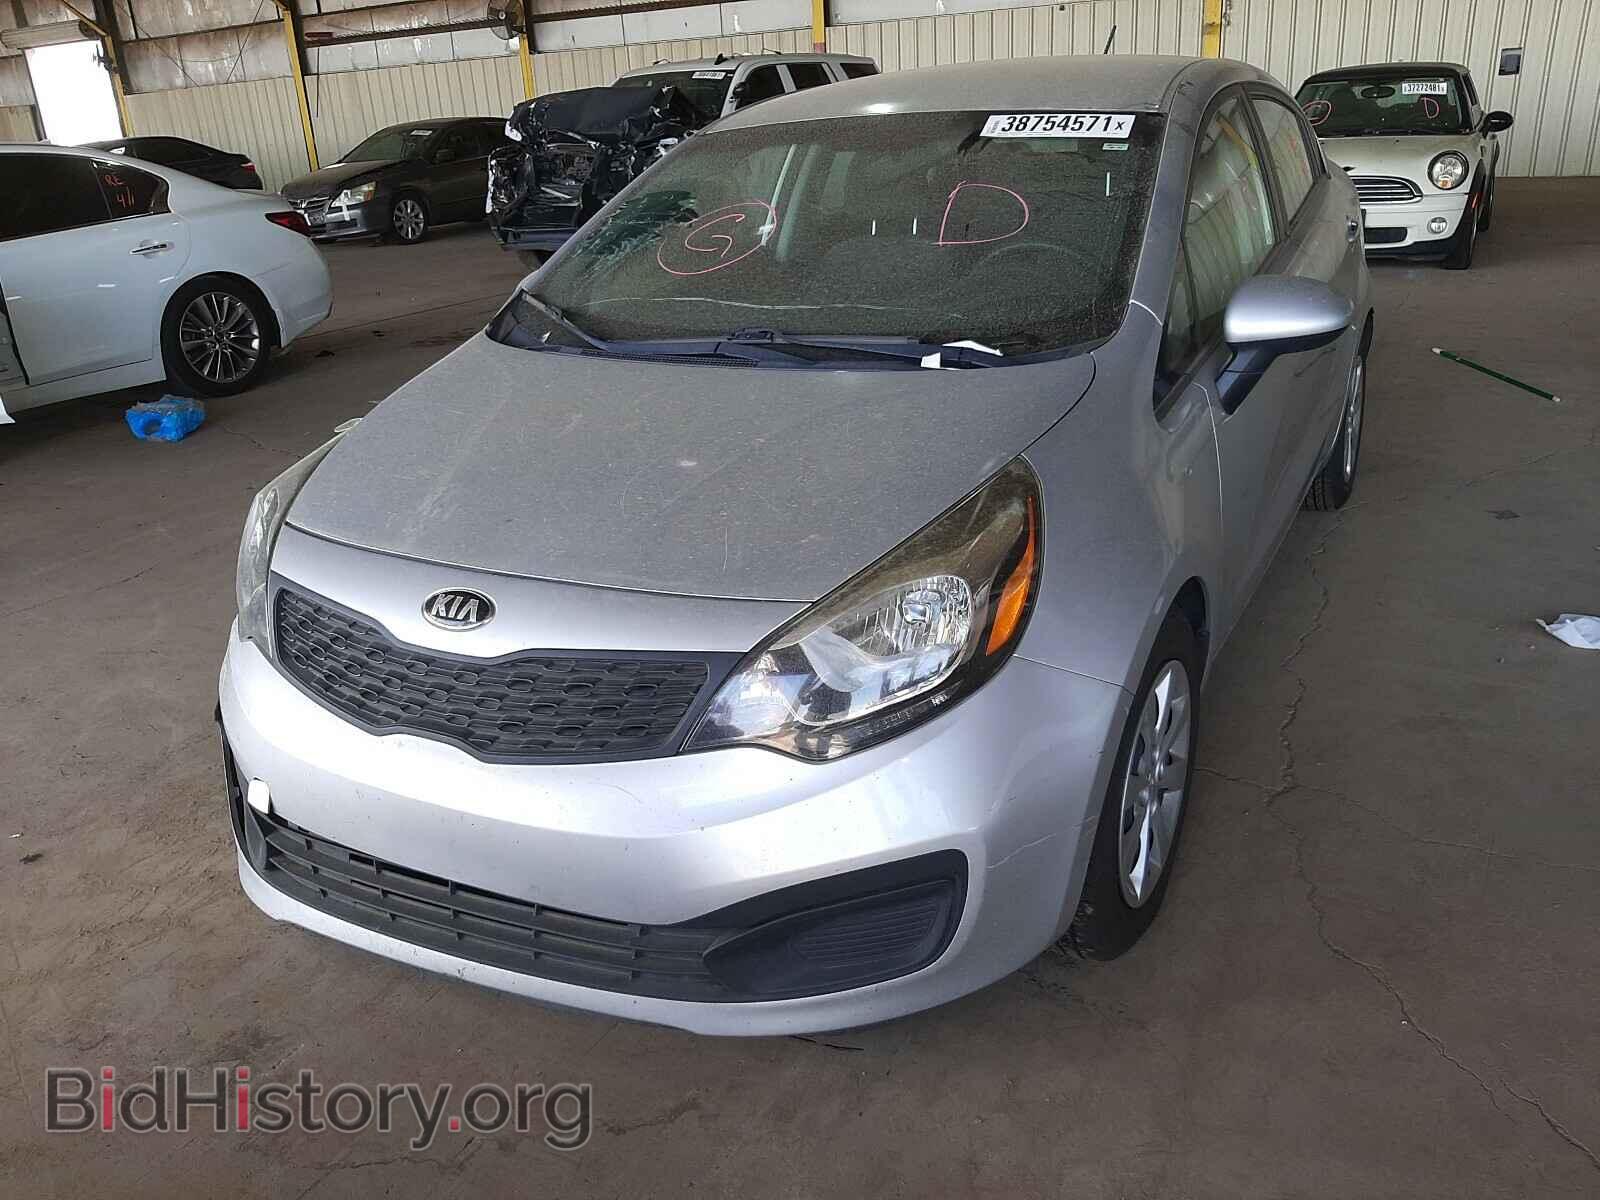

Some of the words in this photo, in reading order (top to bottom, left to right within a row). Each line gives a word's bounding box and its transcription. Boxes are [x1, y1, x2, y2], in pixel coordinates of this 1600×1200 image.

[1420, 97, 1440, 119] D
[1002, 115, 1113, 132] 38754571
[931, 181, 1029, 247] D
[685, 213, 745, 258] G
[431, 593, 480, 623] KIA
